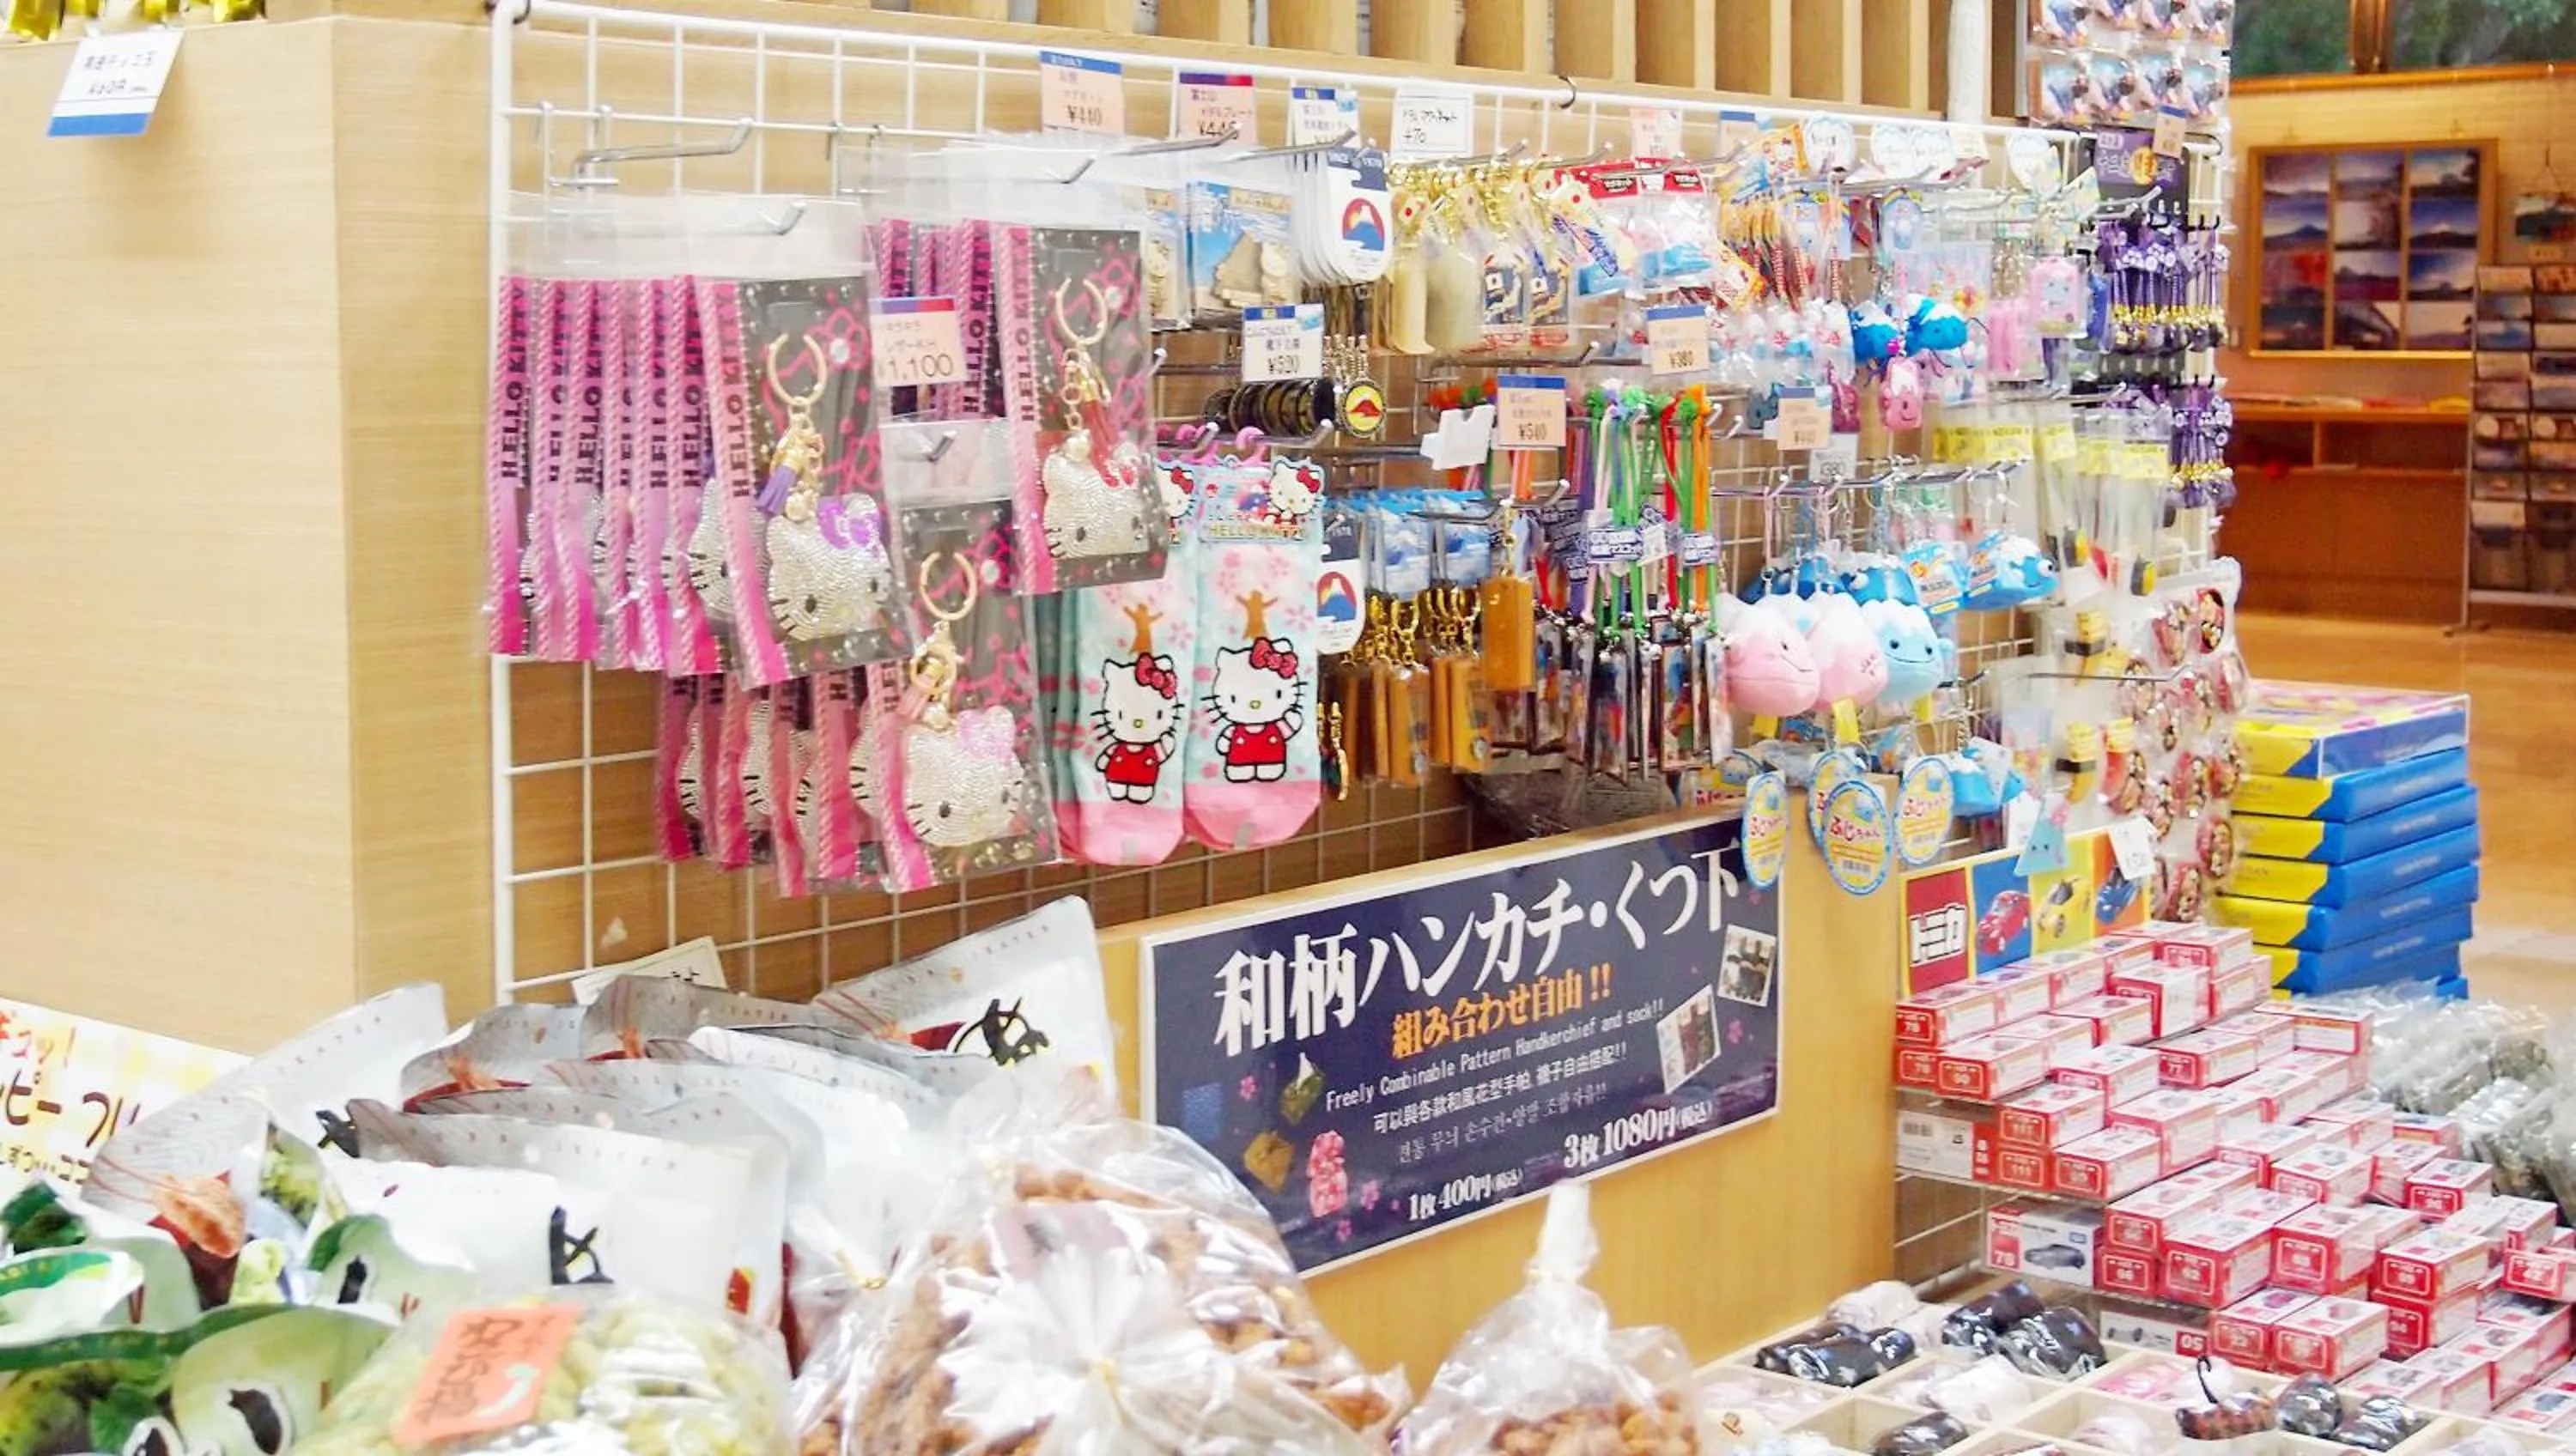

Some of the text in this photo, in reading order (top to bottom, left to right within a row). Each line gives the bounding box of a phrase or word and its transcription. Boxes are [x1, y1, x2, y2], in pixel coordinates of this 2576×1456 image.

[963, 318, 985, 413] HELLO
[1016, 327, 1035, 422] HELLO
[501, 380, 525, 478] HELLO
[574, 386, 602, 483] HELLO
[683, 385, 702, 487] HELLO
[728, 394, 750, 497] HELLO
[1326, 997, 1664, 1113] Freely Combinable Pattern Handkerchief and sock!!
